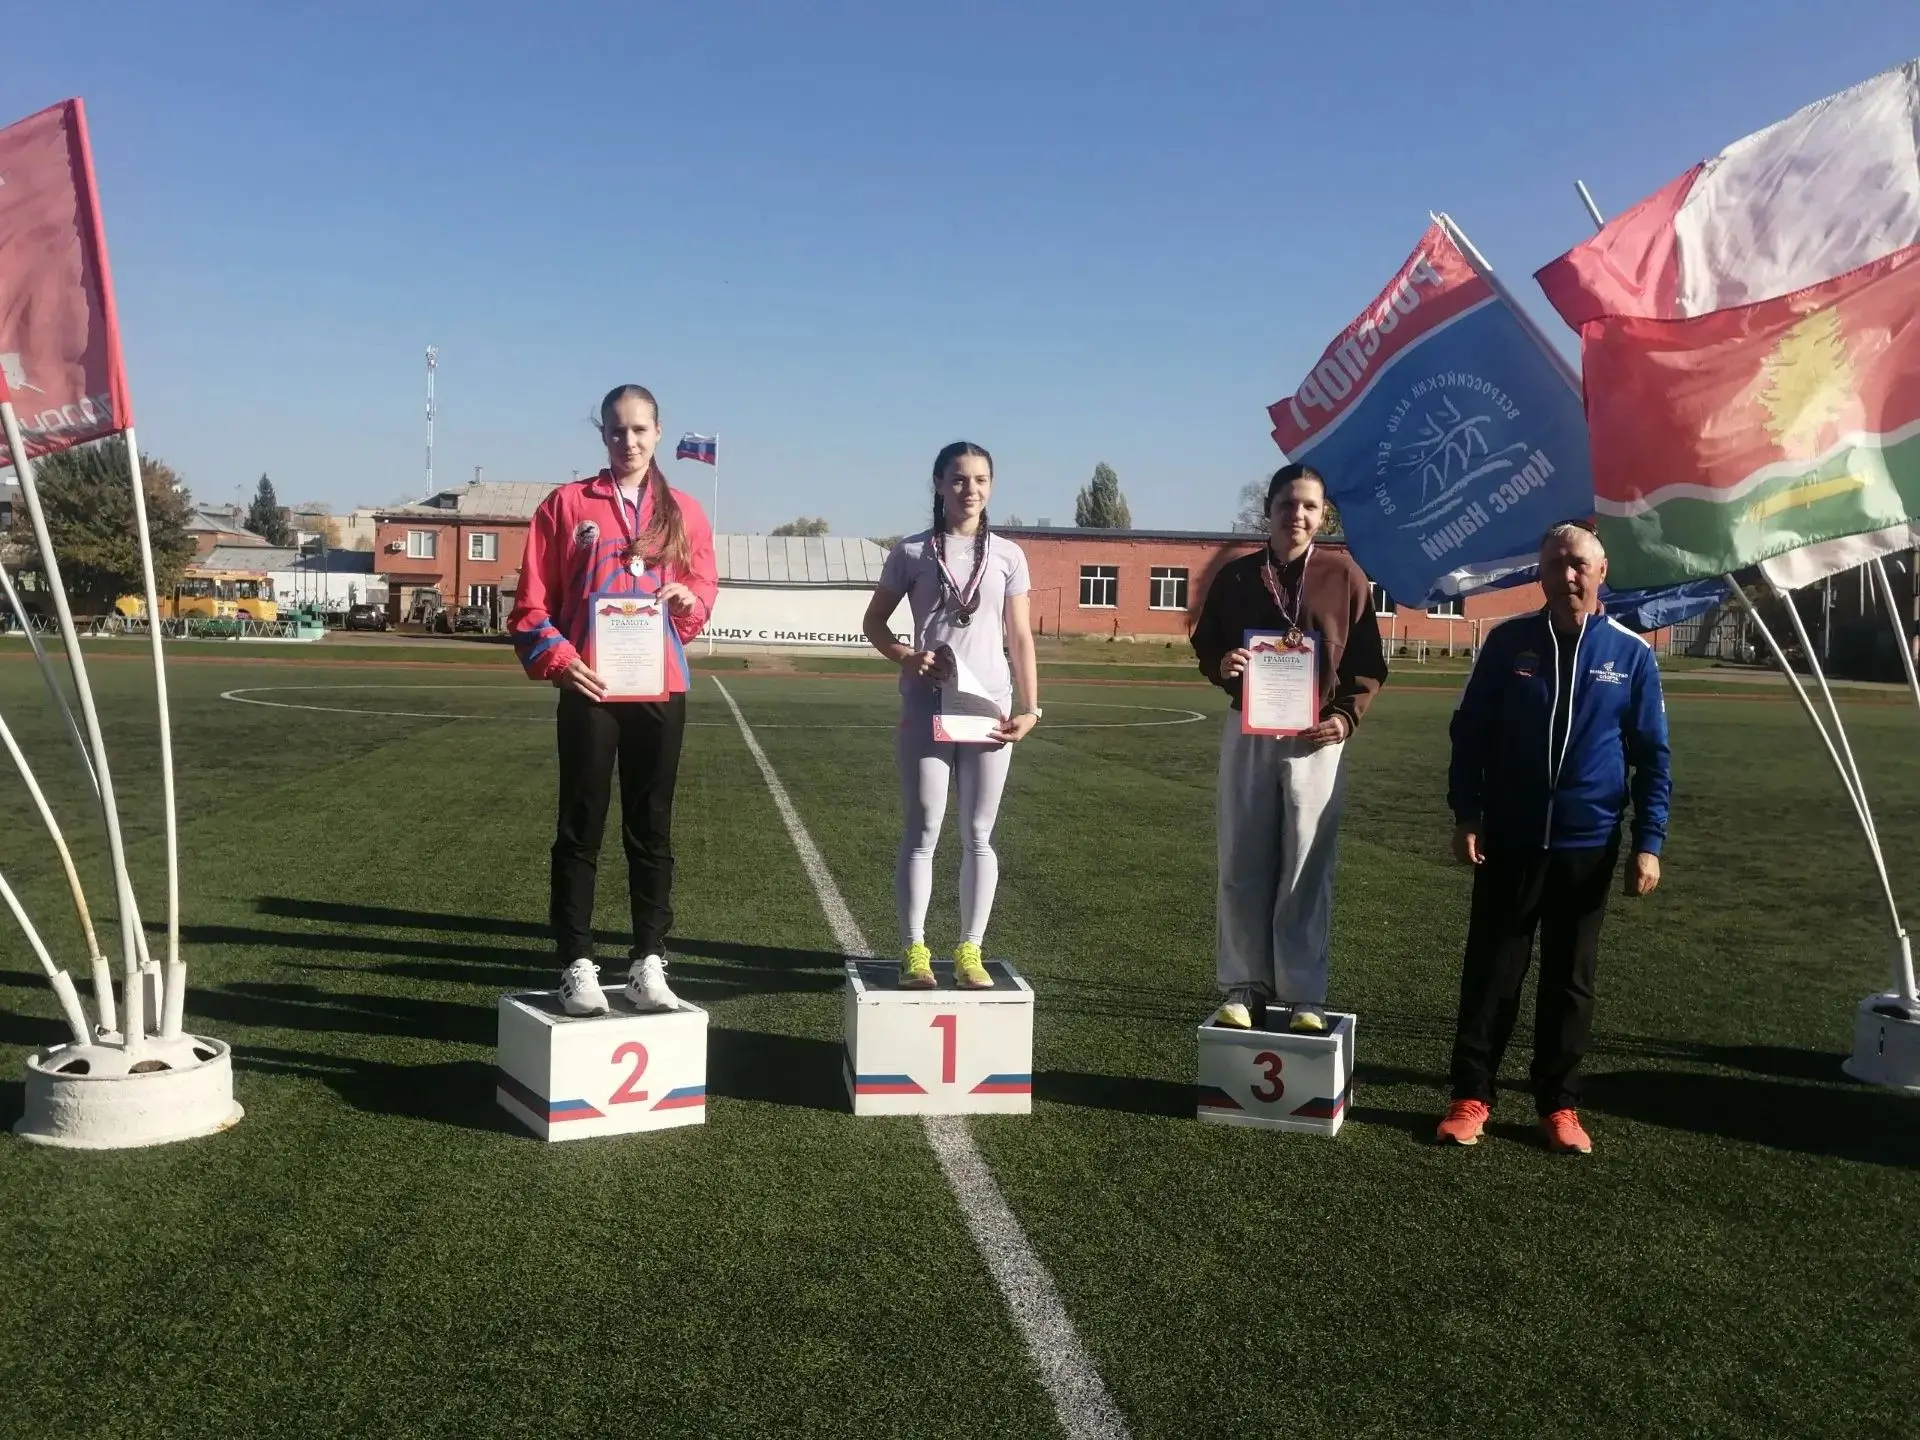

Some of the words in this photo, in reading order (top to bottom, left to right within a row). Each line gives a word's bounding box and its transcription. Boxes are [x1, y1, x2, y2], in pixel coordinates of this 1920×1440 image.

[758, 630, 768, 639] С
[1263, 656, 1300, 664] ГРАМОТА
[610, 1041, 649, 1105] 2
[931, 1015, 957, 1084] 1
[1251, 1051, 1284, 1103] 3
